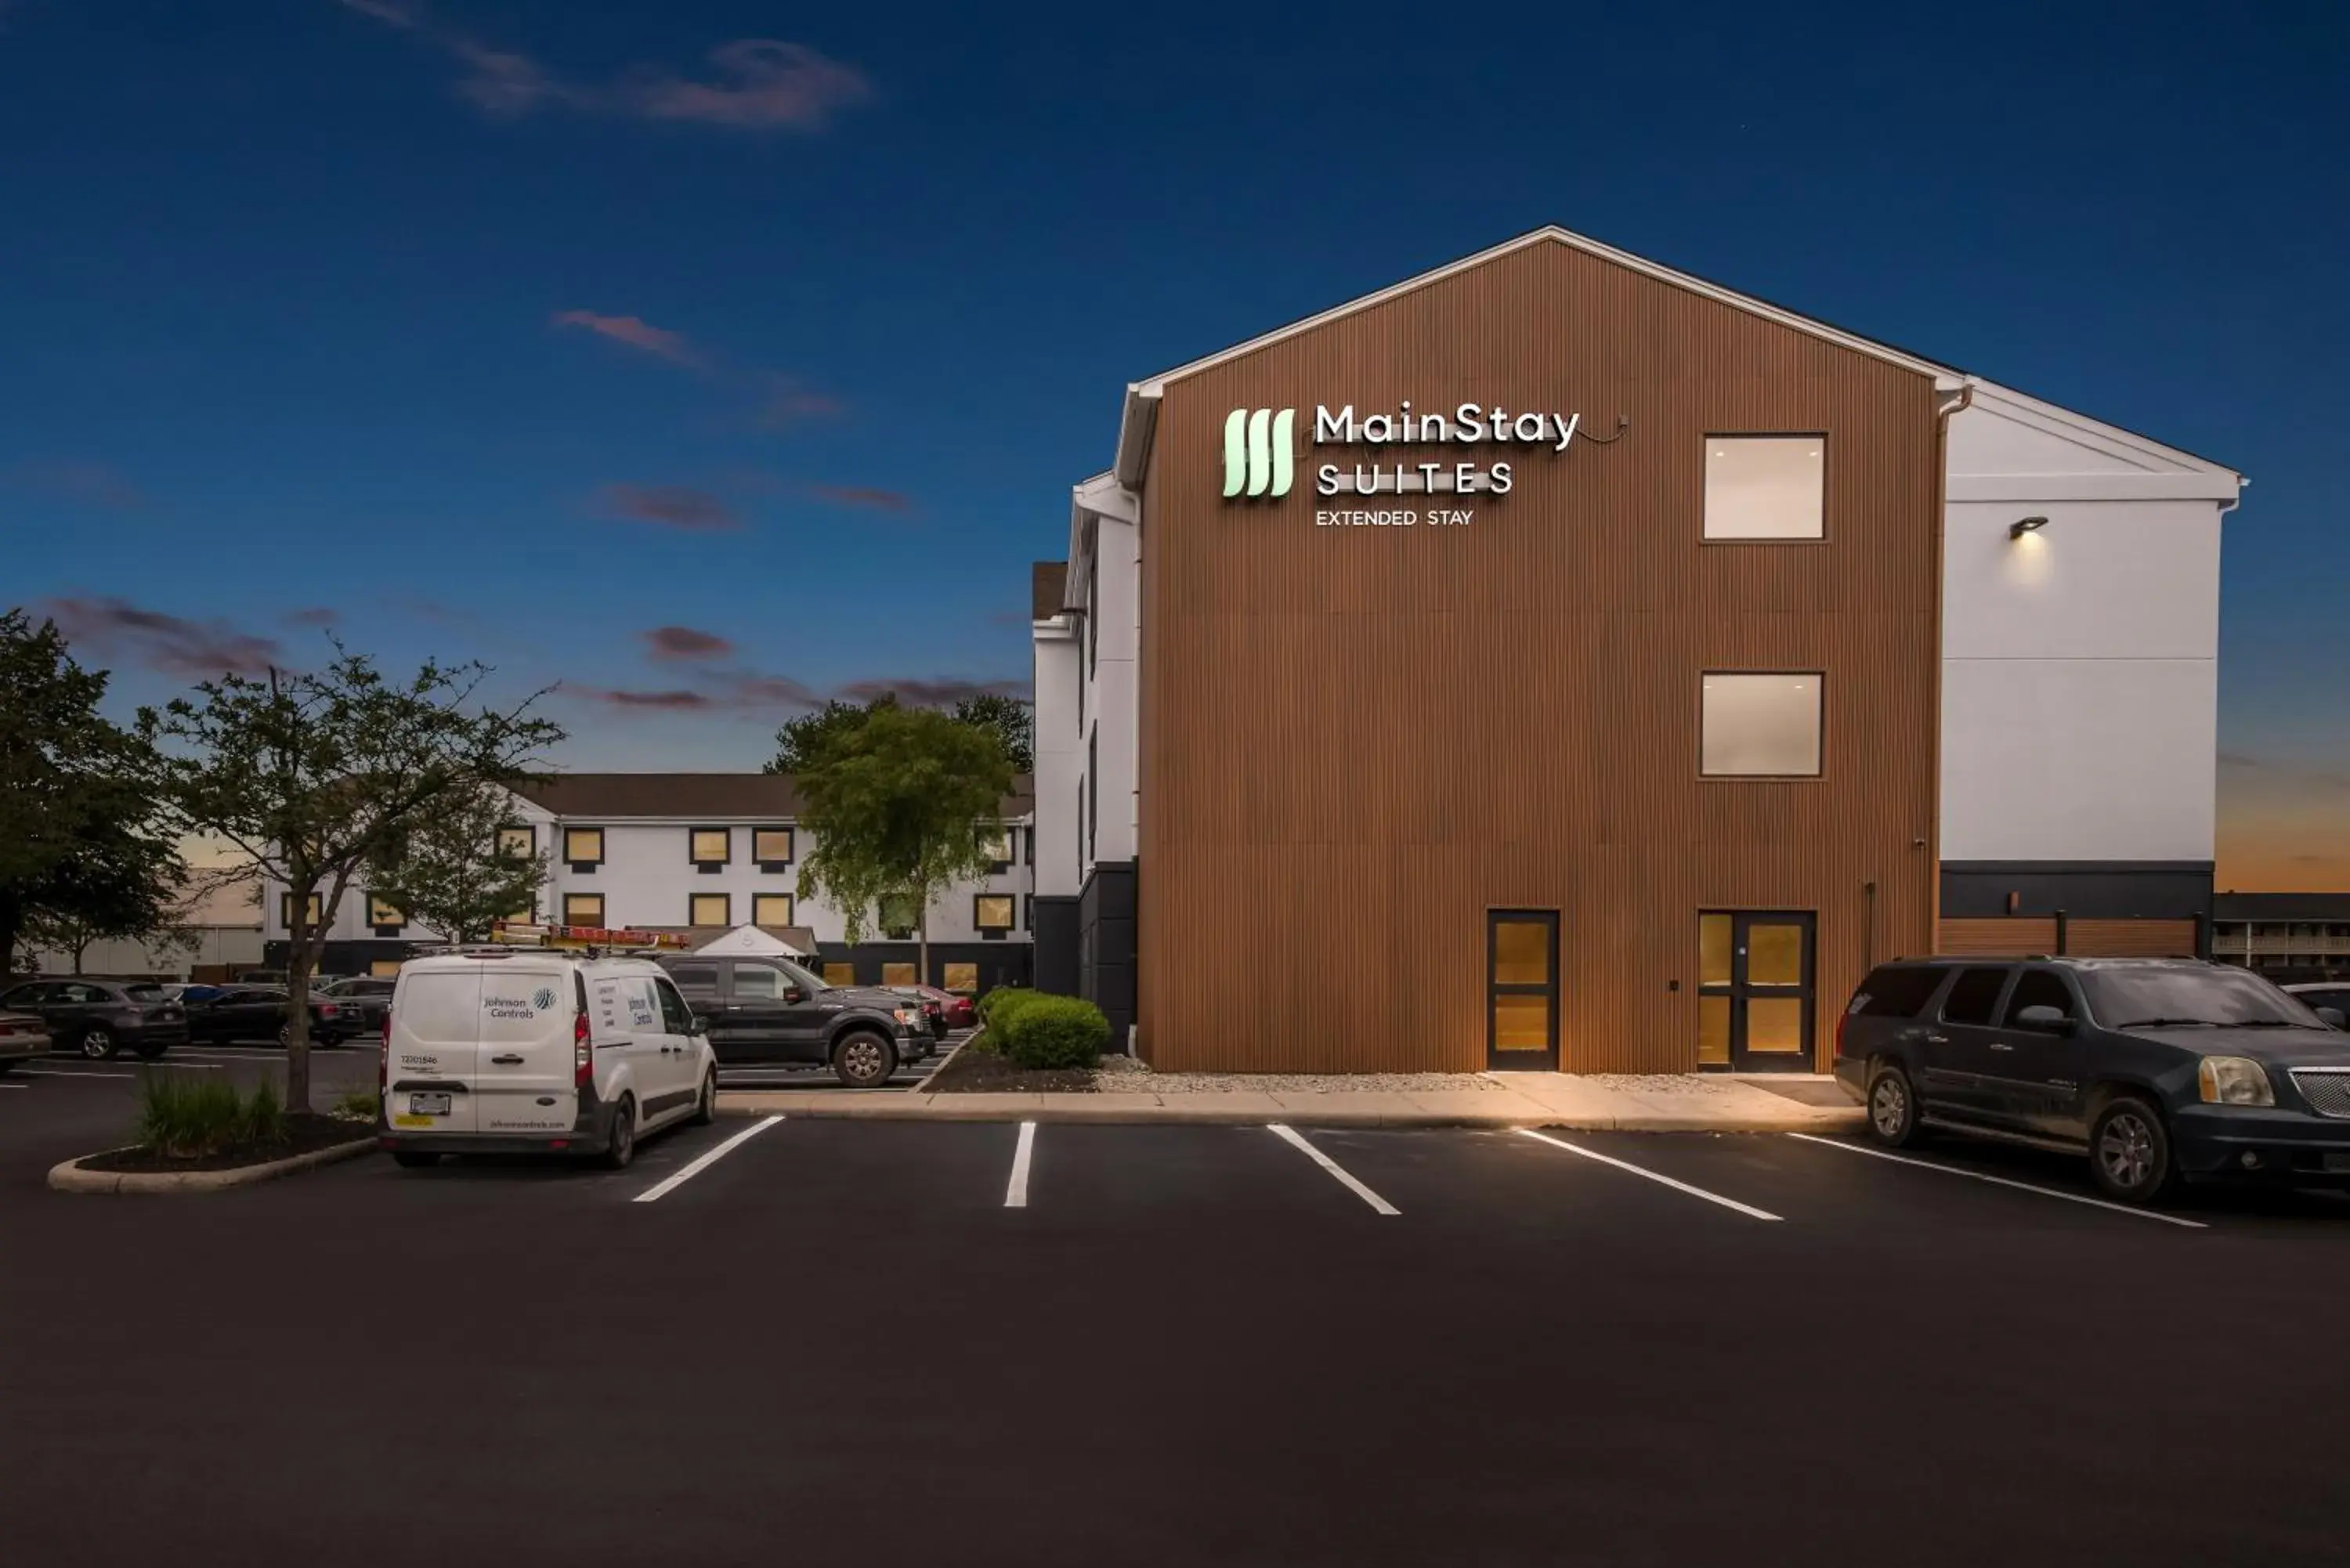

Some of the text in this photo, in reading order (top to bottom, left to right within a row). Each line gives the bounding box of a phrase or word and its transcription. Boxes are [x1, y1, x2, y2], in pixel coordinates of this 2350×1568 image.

[1315, 400, 1580, 451] MainStay
[1317, 462, 1513, 495] SUITES
[1316, 510, 1474, 526] EXTENDED STAY
[484, 996, 526, 1009] Johnson
[490, 1007, 534, 1019] Controls
